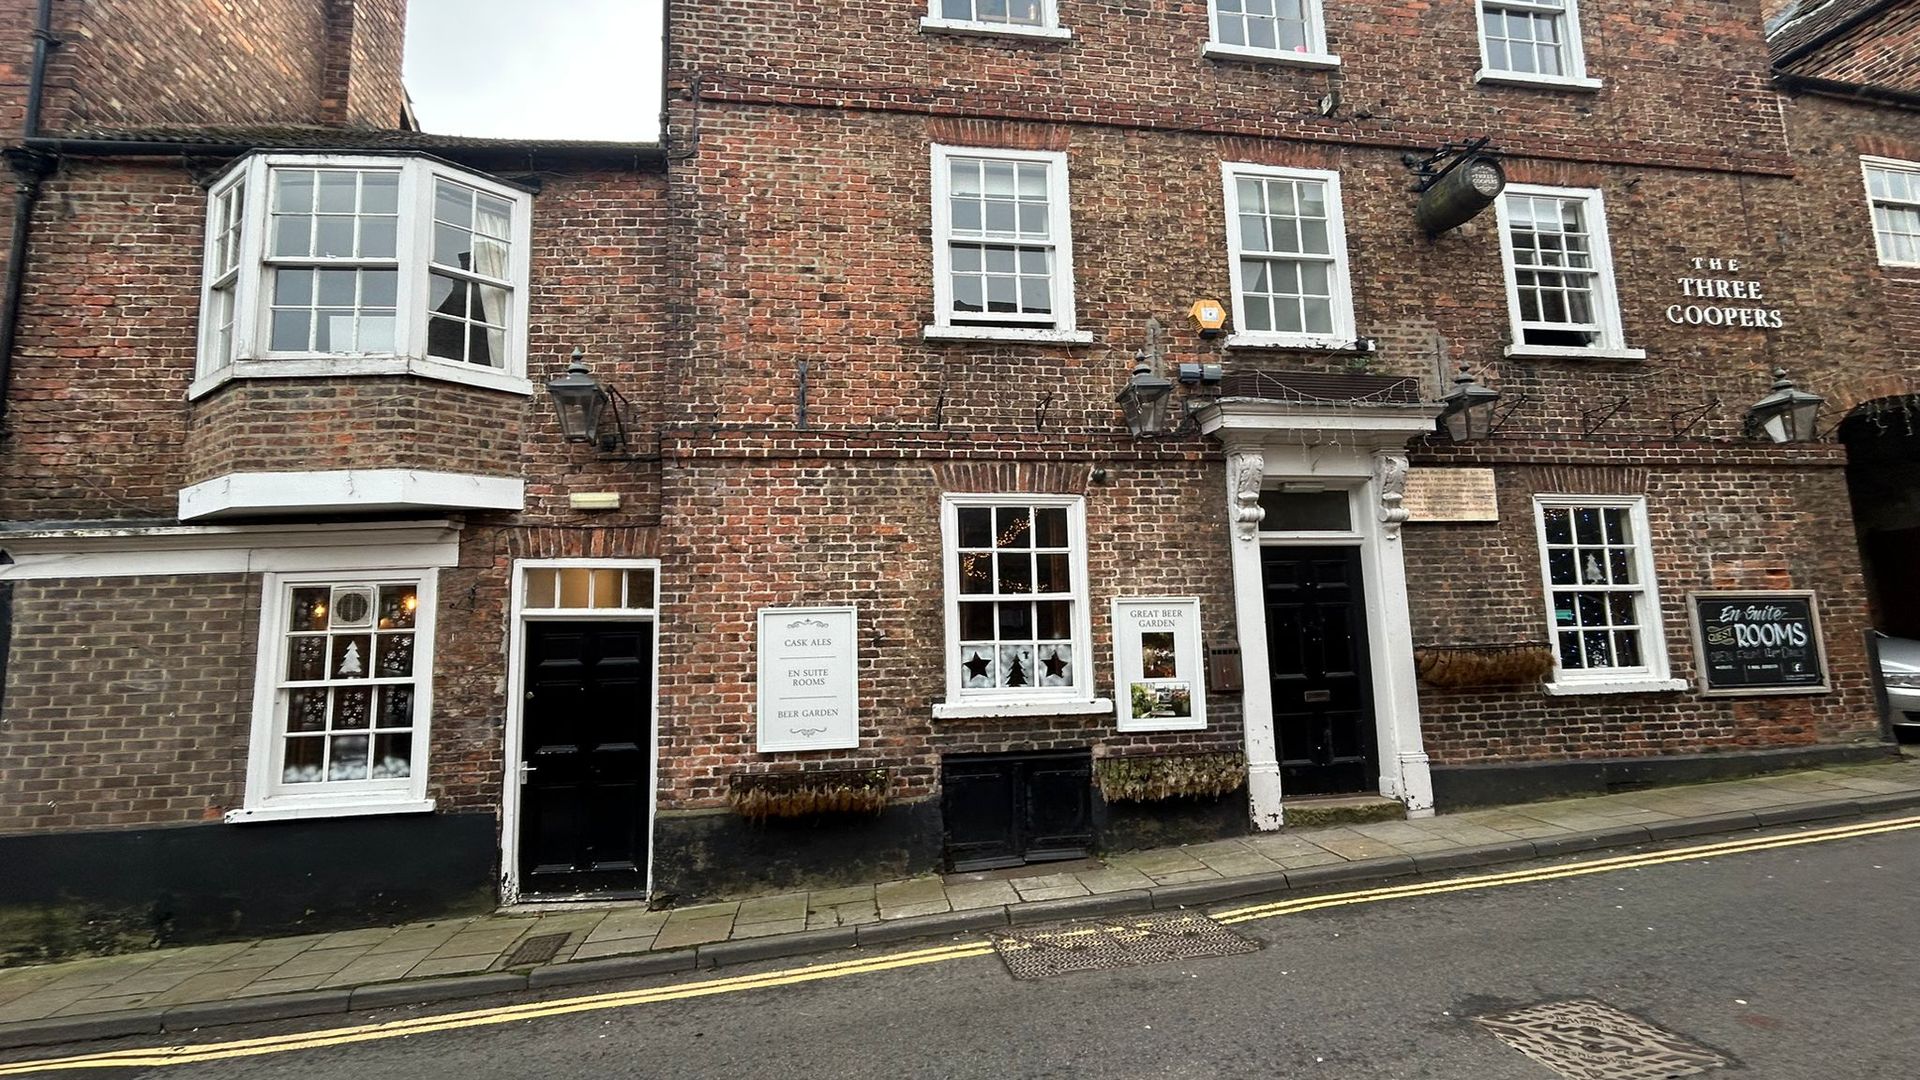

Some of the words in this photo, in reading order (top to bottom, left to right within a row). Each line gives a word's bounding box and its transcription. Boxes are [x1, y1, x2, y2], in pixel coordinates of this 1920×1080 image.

[1691, 257, 1739, 271] THE
[1677, 277, 1763, 299] THREE
[1666, 304, 1783, 329] COOPERS
[1130, 609, 1159, 618] GREAT
[1162, 609, 1183, 617] BEER
[1720, 605, 1740, 622] En
[1745, 605, 1782, 621] Suite
[1138, 619, 1175, 628] GARDEN
[1733, 622, 1807, 647] ROOMS
[784, 639, 808, 647] CASK
[811, 638, 832, 646] ALES
[788, 669, 800, 678] EN
[803, 669, 829, 677] SUITE
[792, 678, 825, 687] ROOMS
[777, 710, 800, 718] BEER
[802, 708, 839, 718] GARDEN
